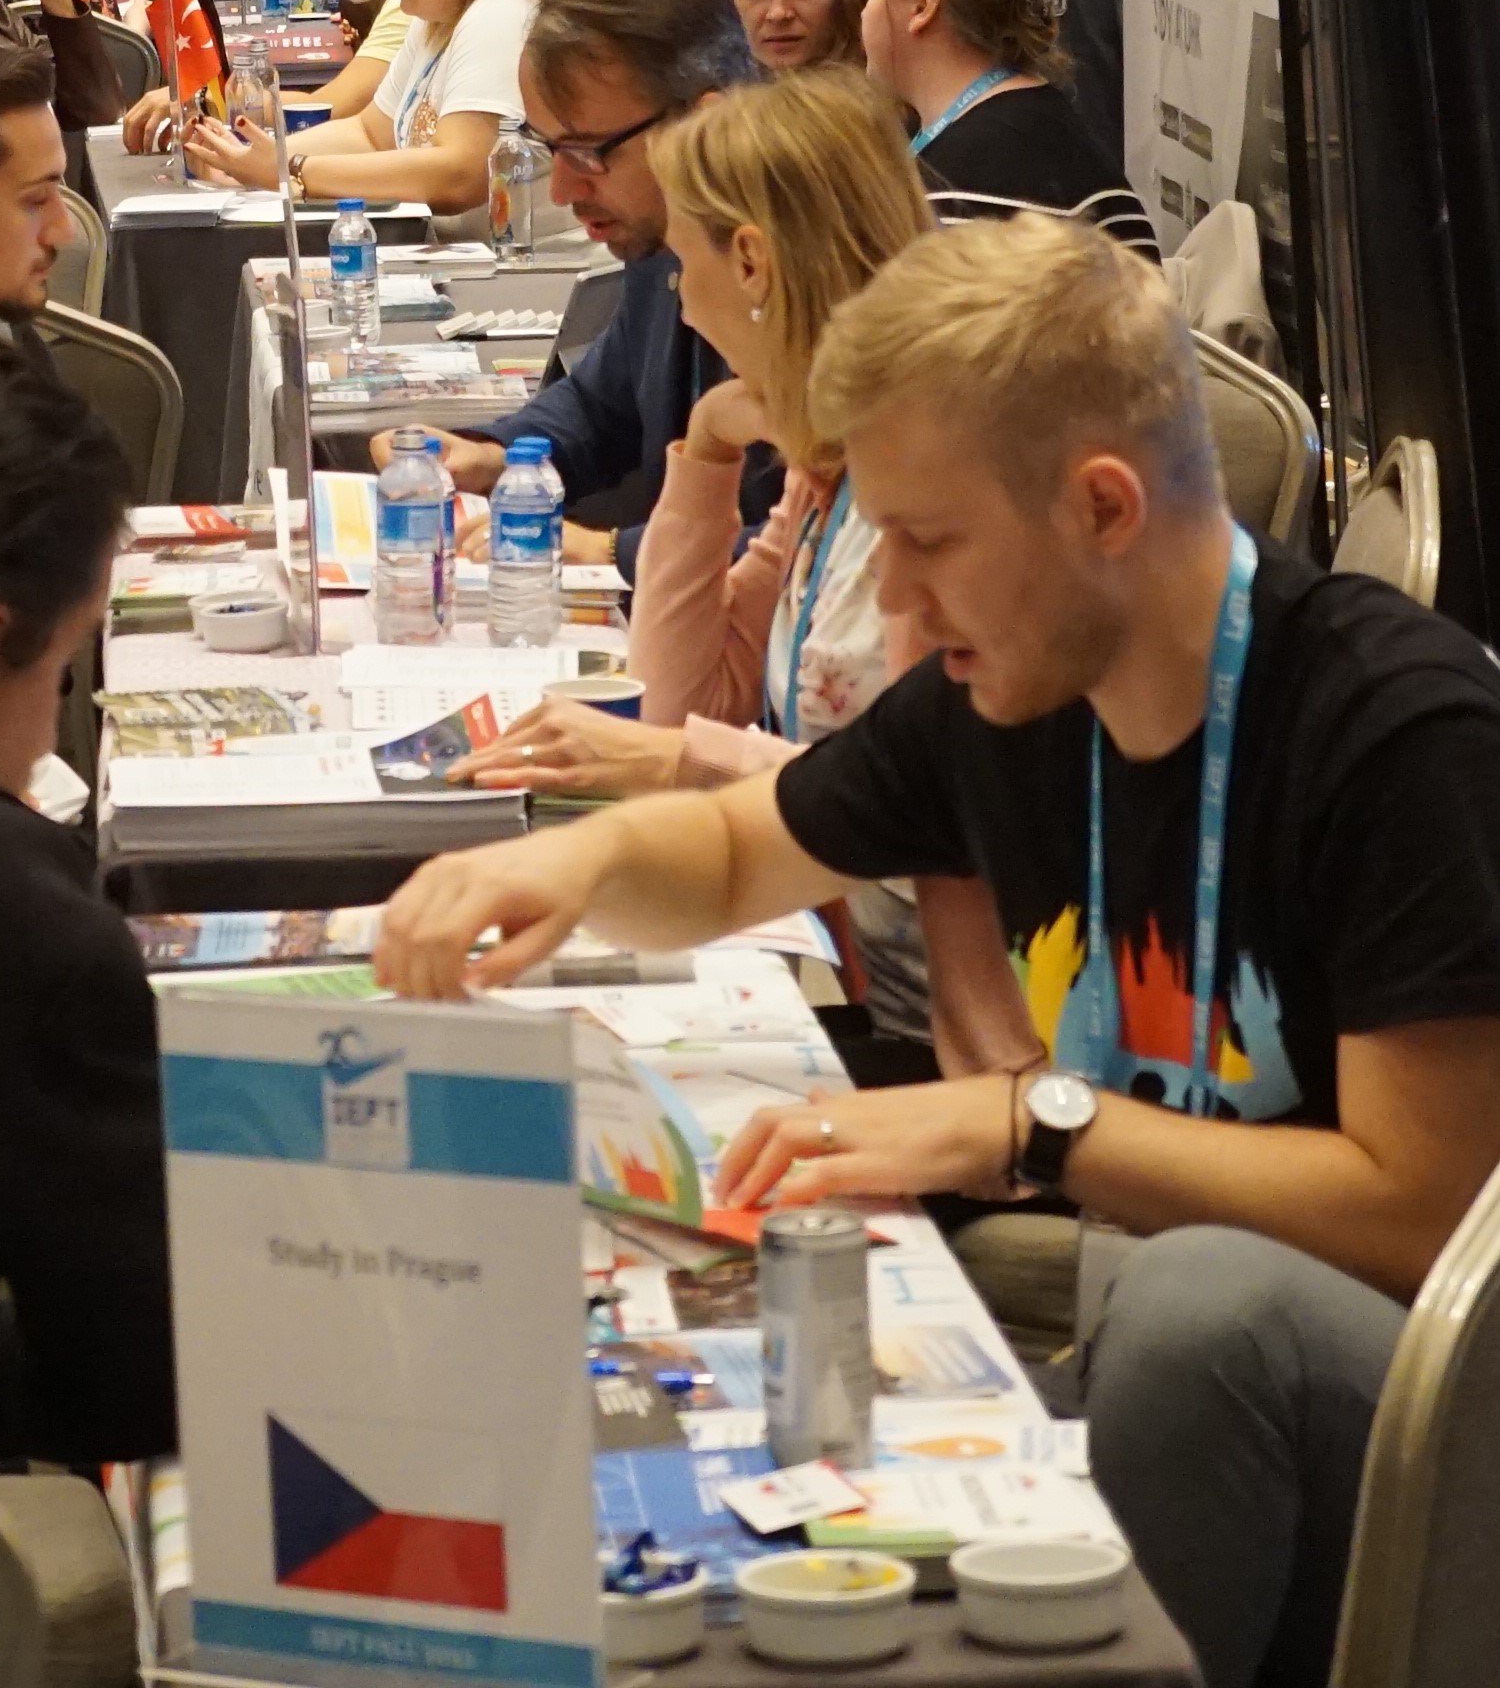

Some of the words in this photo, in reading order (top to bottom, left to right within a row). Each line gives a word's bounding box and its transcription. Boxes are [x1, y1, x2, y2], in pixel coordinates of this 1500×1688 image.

[268, 1235, 345, 1280] Study
[352, 1248, 381, 1275] in
[385, 1244, 482, 1291] Prague
